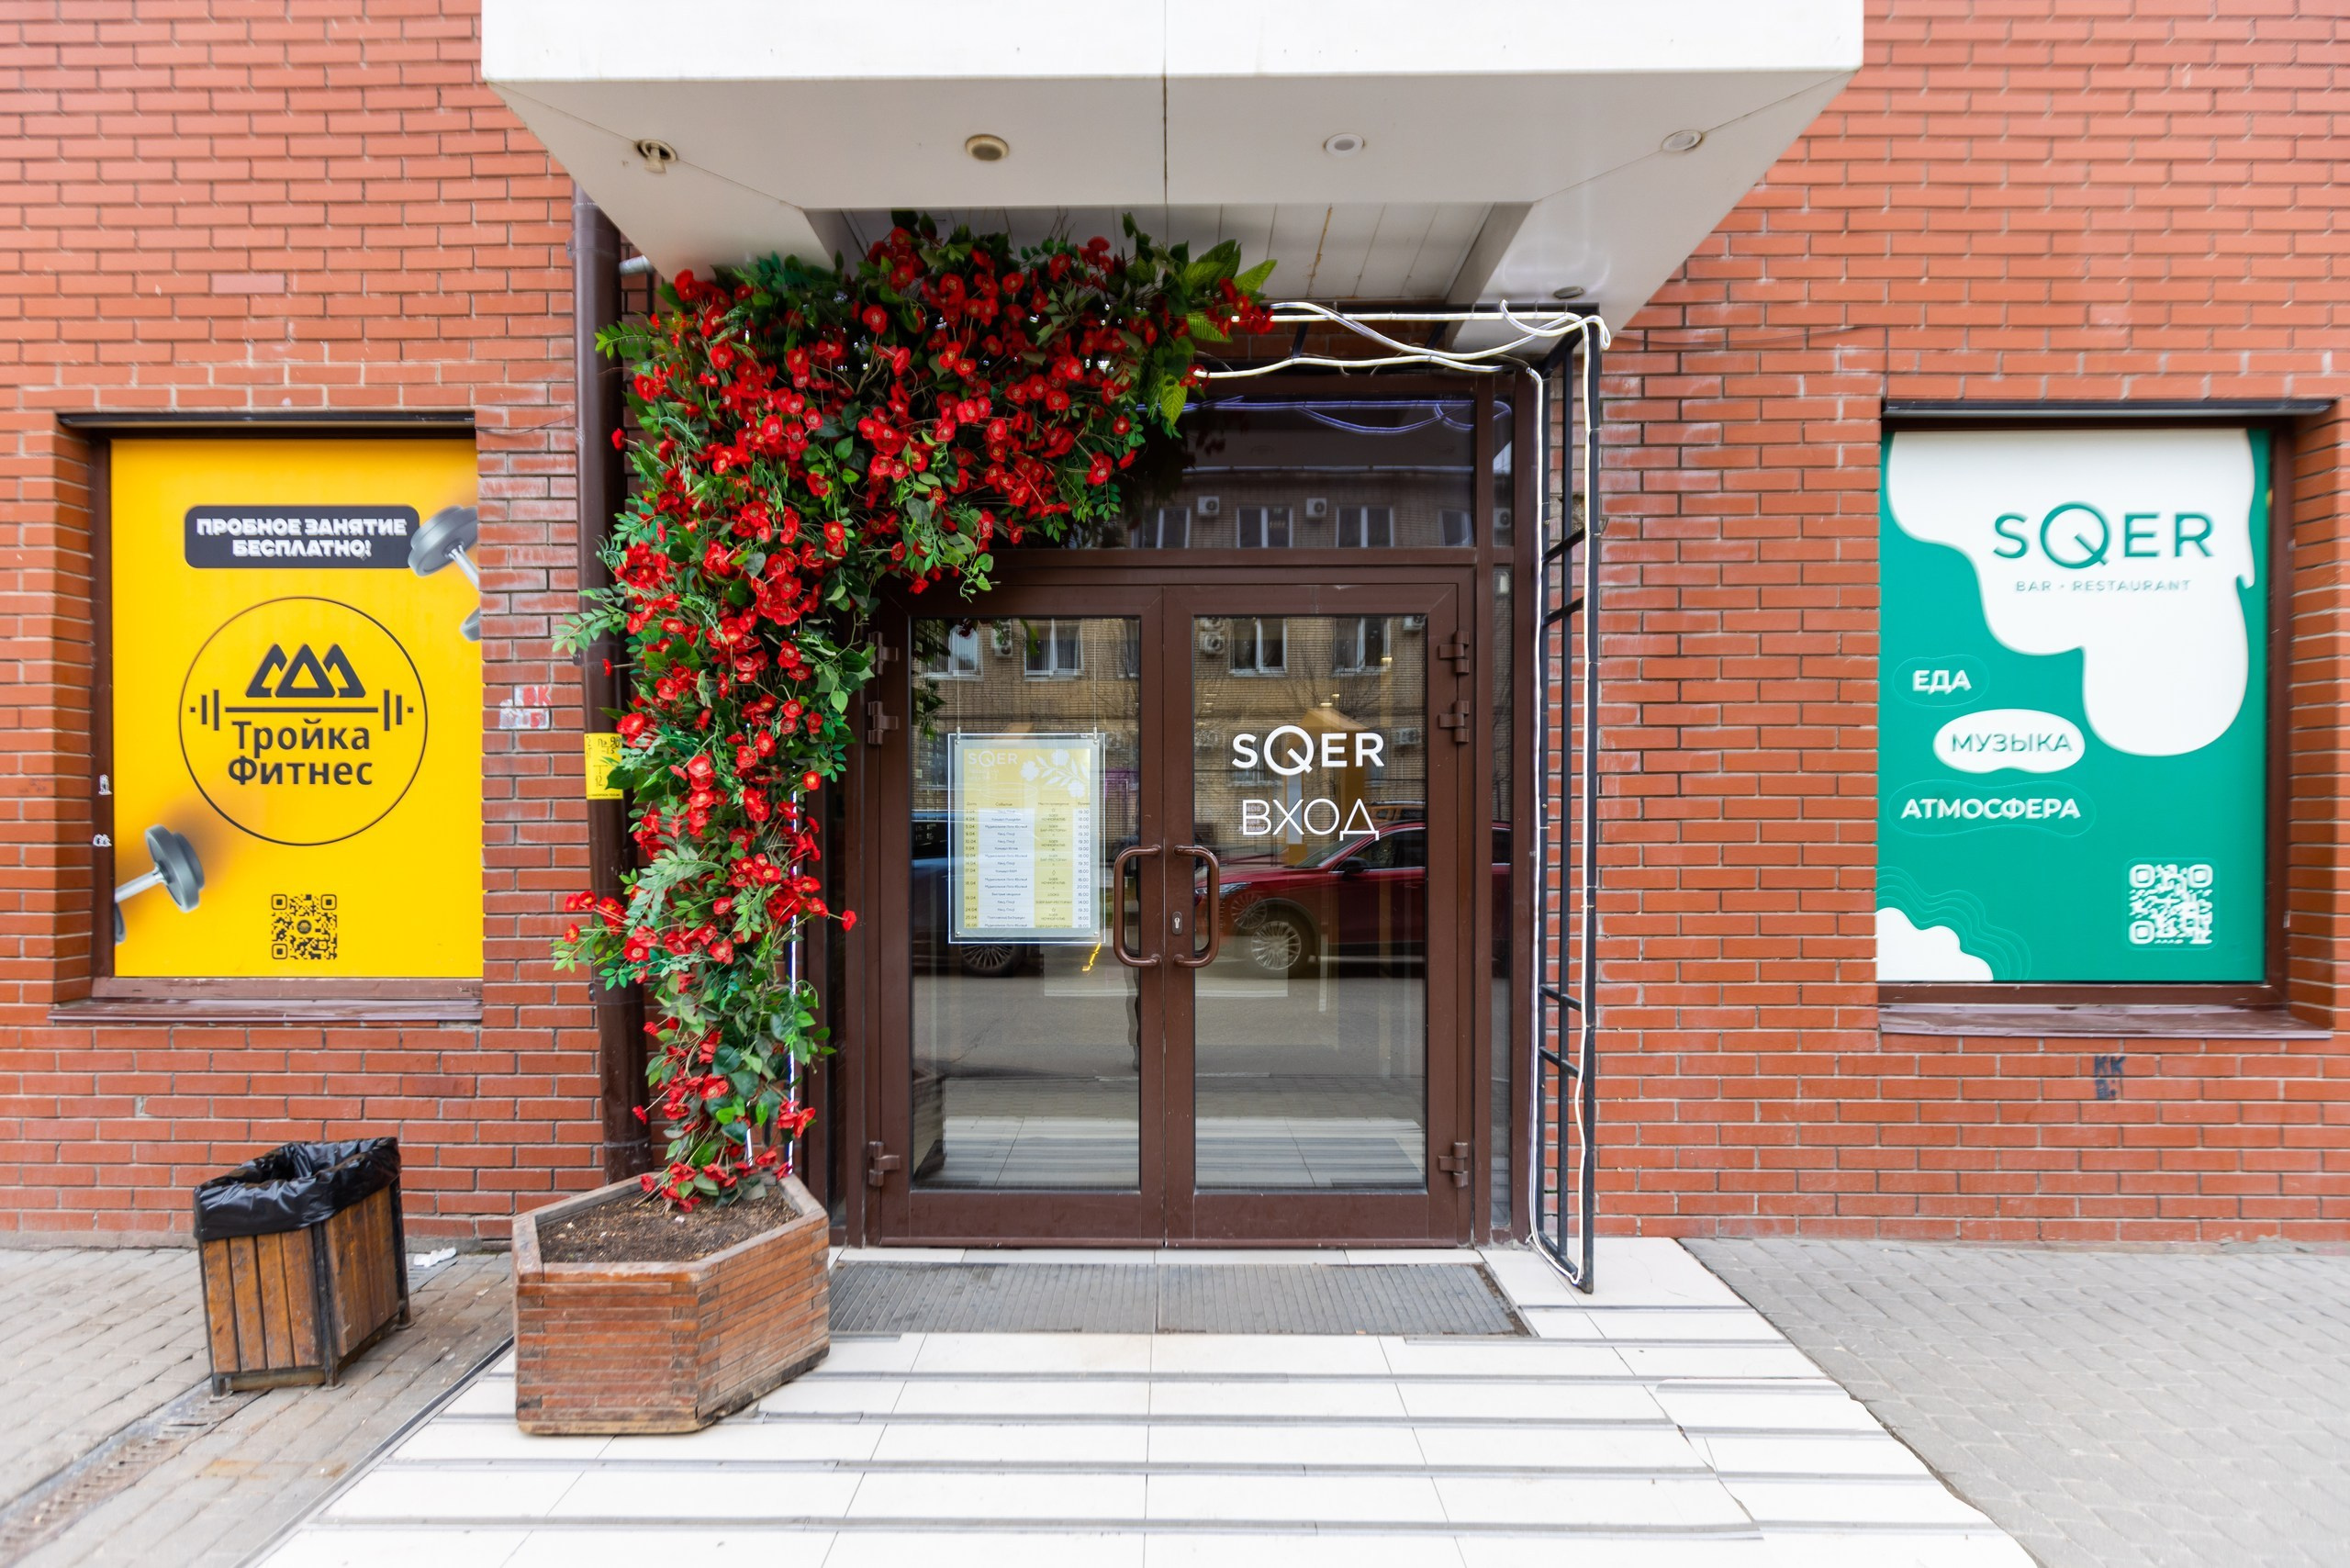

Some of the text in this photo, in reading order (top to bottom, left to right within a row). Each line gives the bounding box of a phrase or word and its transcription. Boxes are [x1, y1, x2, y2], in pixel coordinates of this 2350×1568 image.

[196, 518, 408, 536] ПРОБНОЕ ЗАНЯТИЕ
[1993, 500, 2215, 570] SQER
[231, 539, 373, 557] БЕСПЛАТНО!
[2016, 579, 2191, 592] BAR RESTAURANT
[1912, 669, 1973, 695] ЕДА
[231, 718, 371, 758] Тройка
[1232, 724, 1384, 776] SQER
[1951, 733, 2073, 753] МУЗЫКА
[968, 750, 1019, 767] SQER
[228, 756, 373, 786] Фитнес
[1243, 798, 1380, 842] ВХОД
[1901, 797, 2082, 820] АТМОСФЕРА
